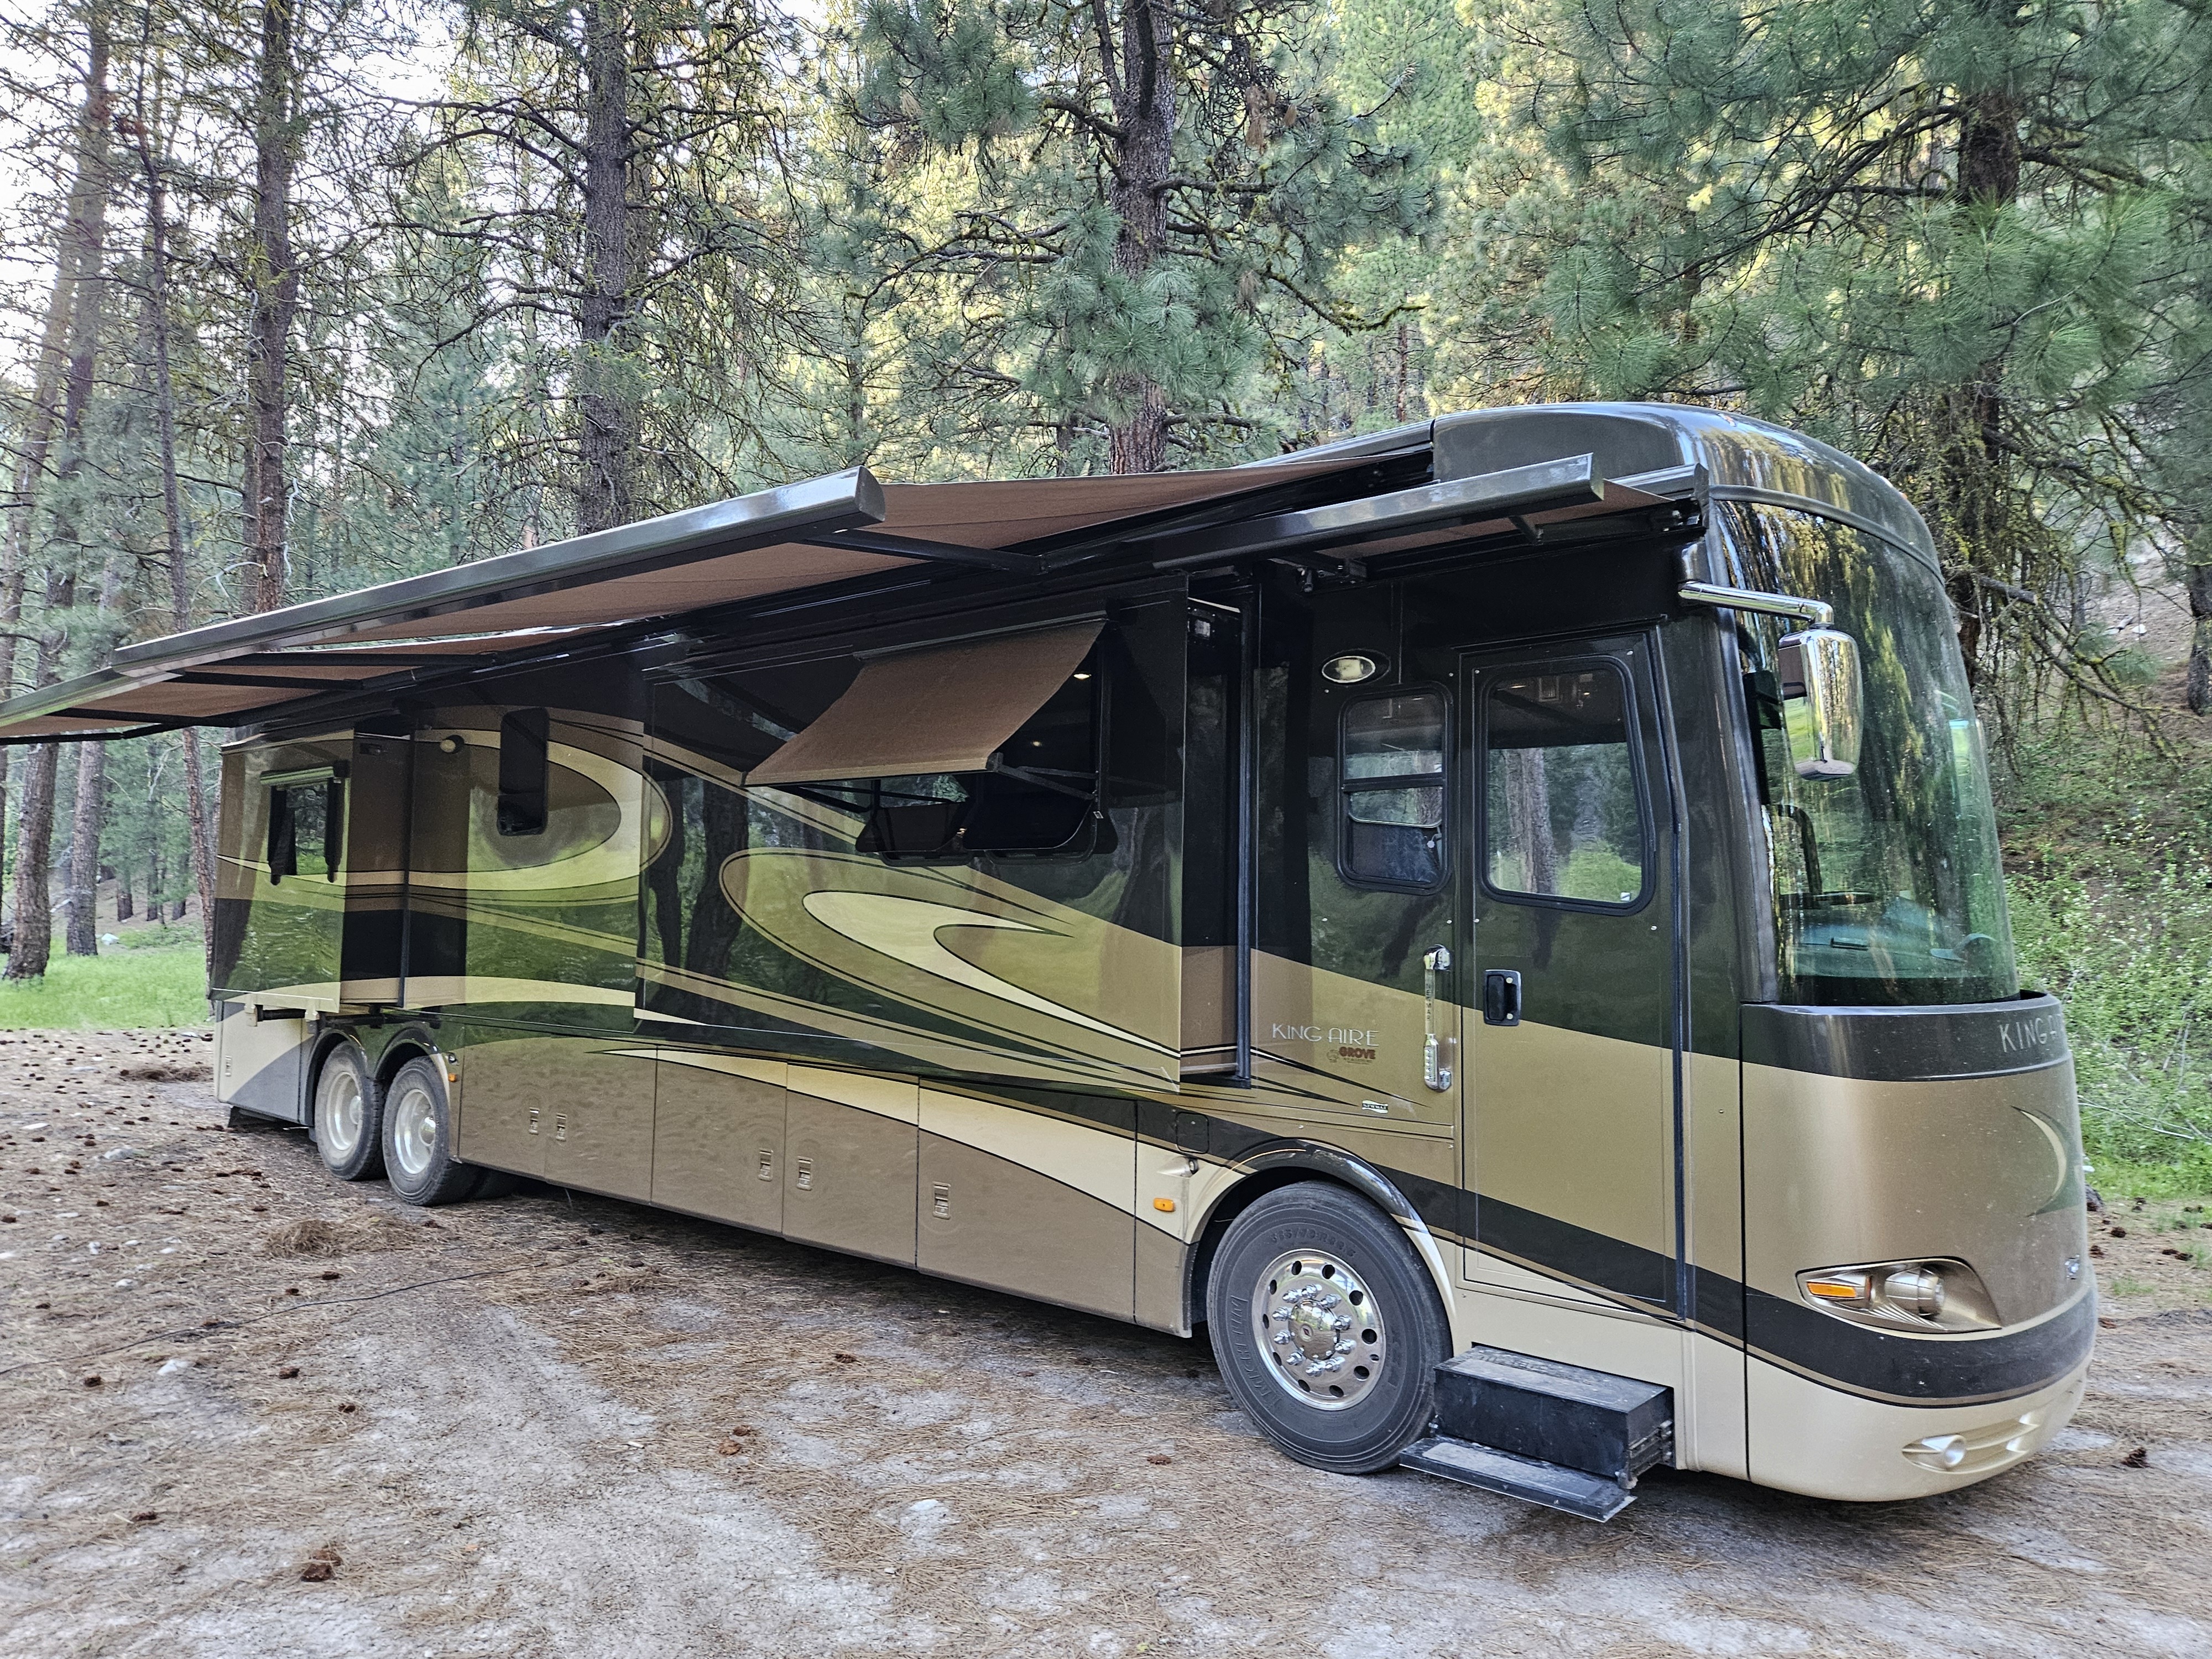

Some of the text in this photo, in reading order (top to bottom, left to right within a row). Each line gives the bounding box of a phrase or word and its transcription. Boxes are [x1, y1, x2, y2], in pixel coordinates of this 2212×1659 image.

[1272, 1023, 1380, 1047] KING AIRE
[1999, 1017, 2047, 1053] KING
[1339, 1046, 1376, 1060] GROVE
